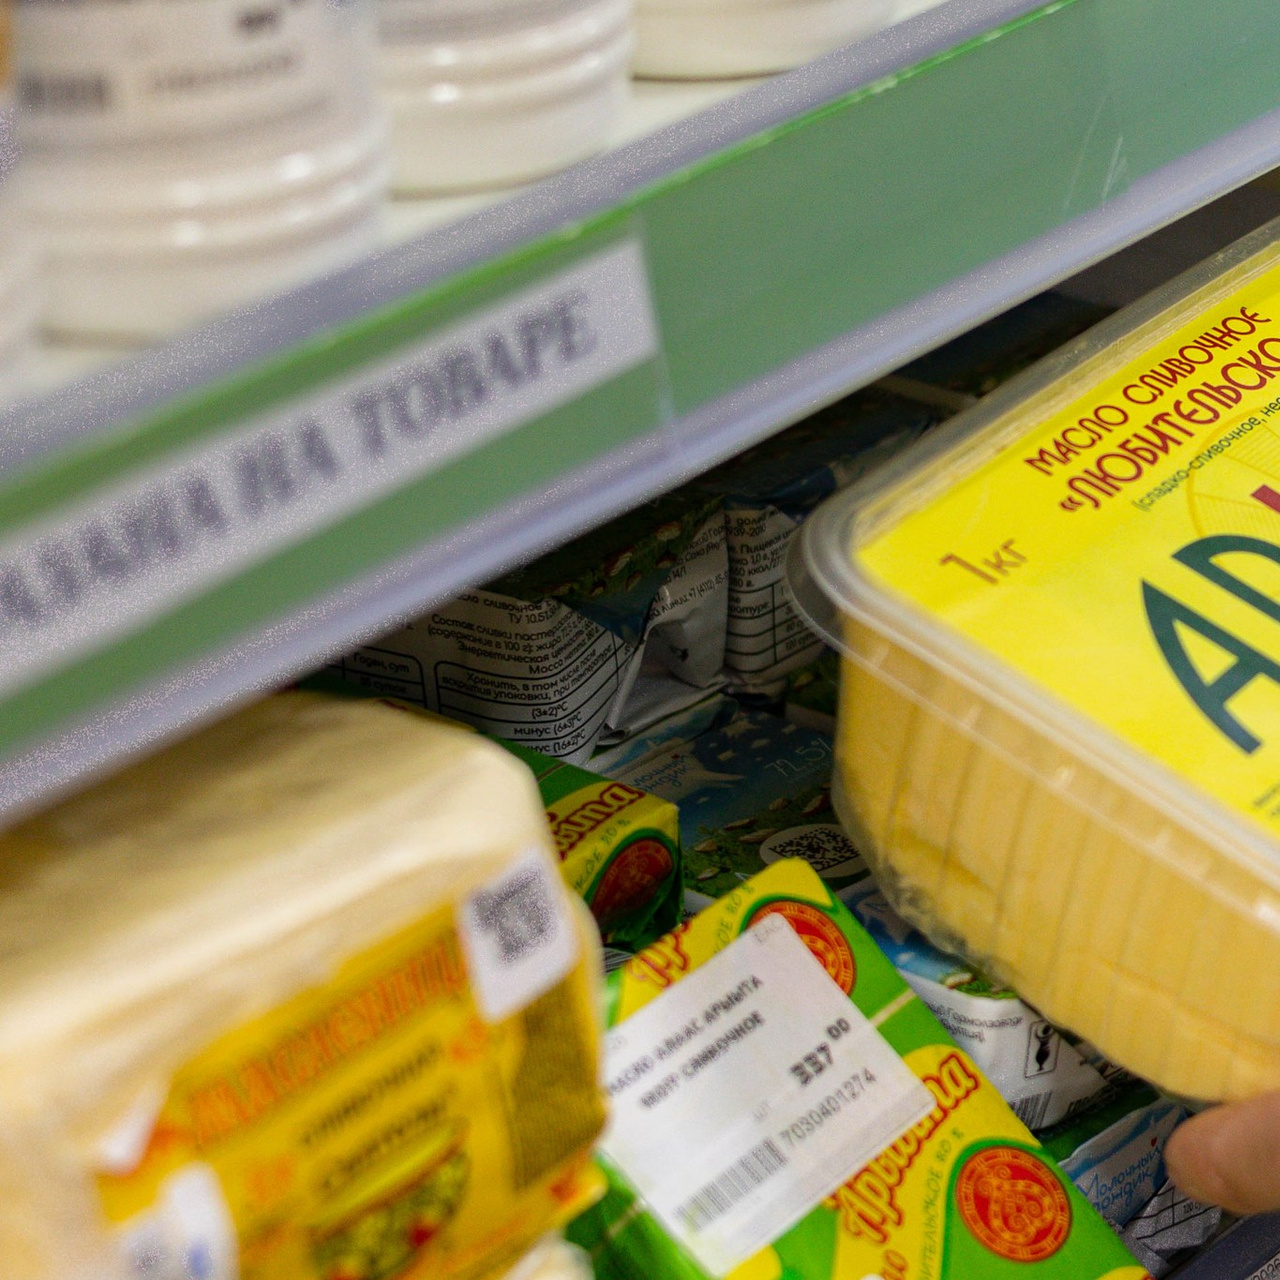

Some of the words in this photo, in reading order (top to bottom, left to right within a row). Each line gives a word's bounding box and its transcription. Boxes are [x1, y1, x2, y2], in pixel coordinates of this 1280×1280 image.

[352, 290, 598, 458] ТОВАРЕ
[1024, 404, 1129, 477] МАСЛО
[1122, 306, 1272, 406] СЛИВОЧНОЕ
[1131, 414, 1267, 512] (сладко-сливочное,
[504, 641, 520, 651] 100
[529, 658, 563, 675] Масса
[467, 672, 520, 691] Хранить,
[531, 680, 558, 691] том
[493, 688, 551, 701] упаковки,
[514, 726, 551, 737] минус
